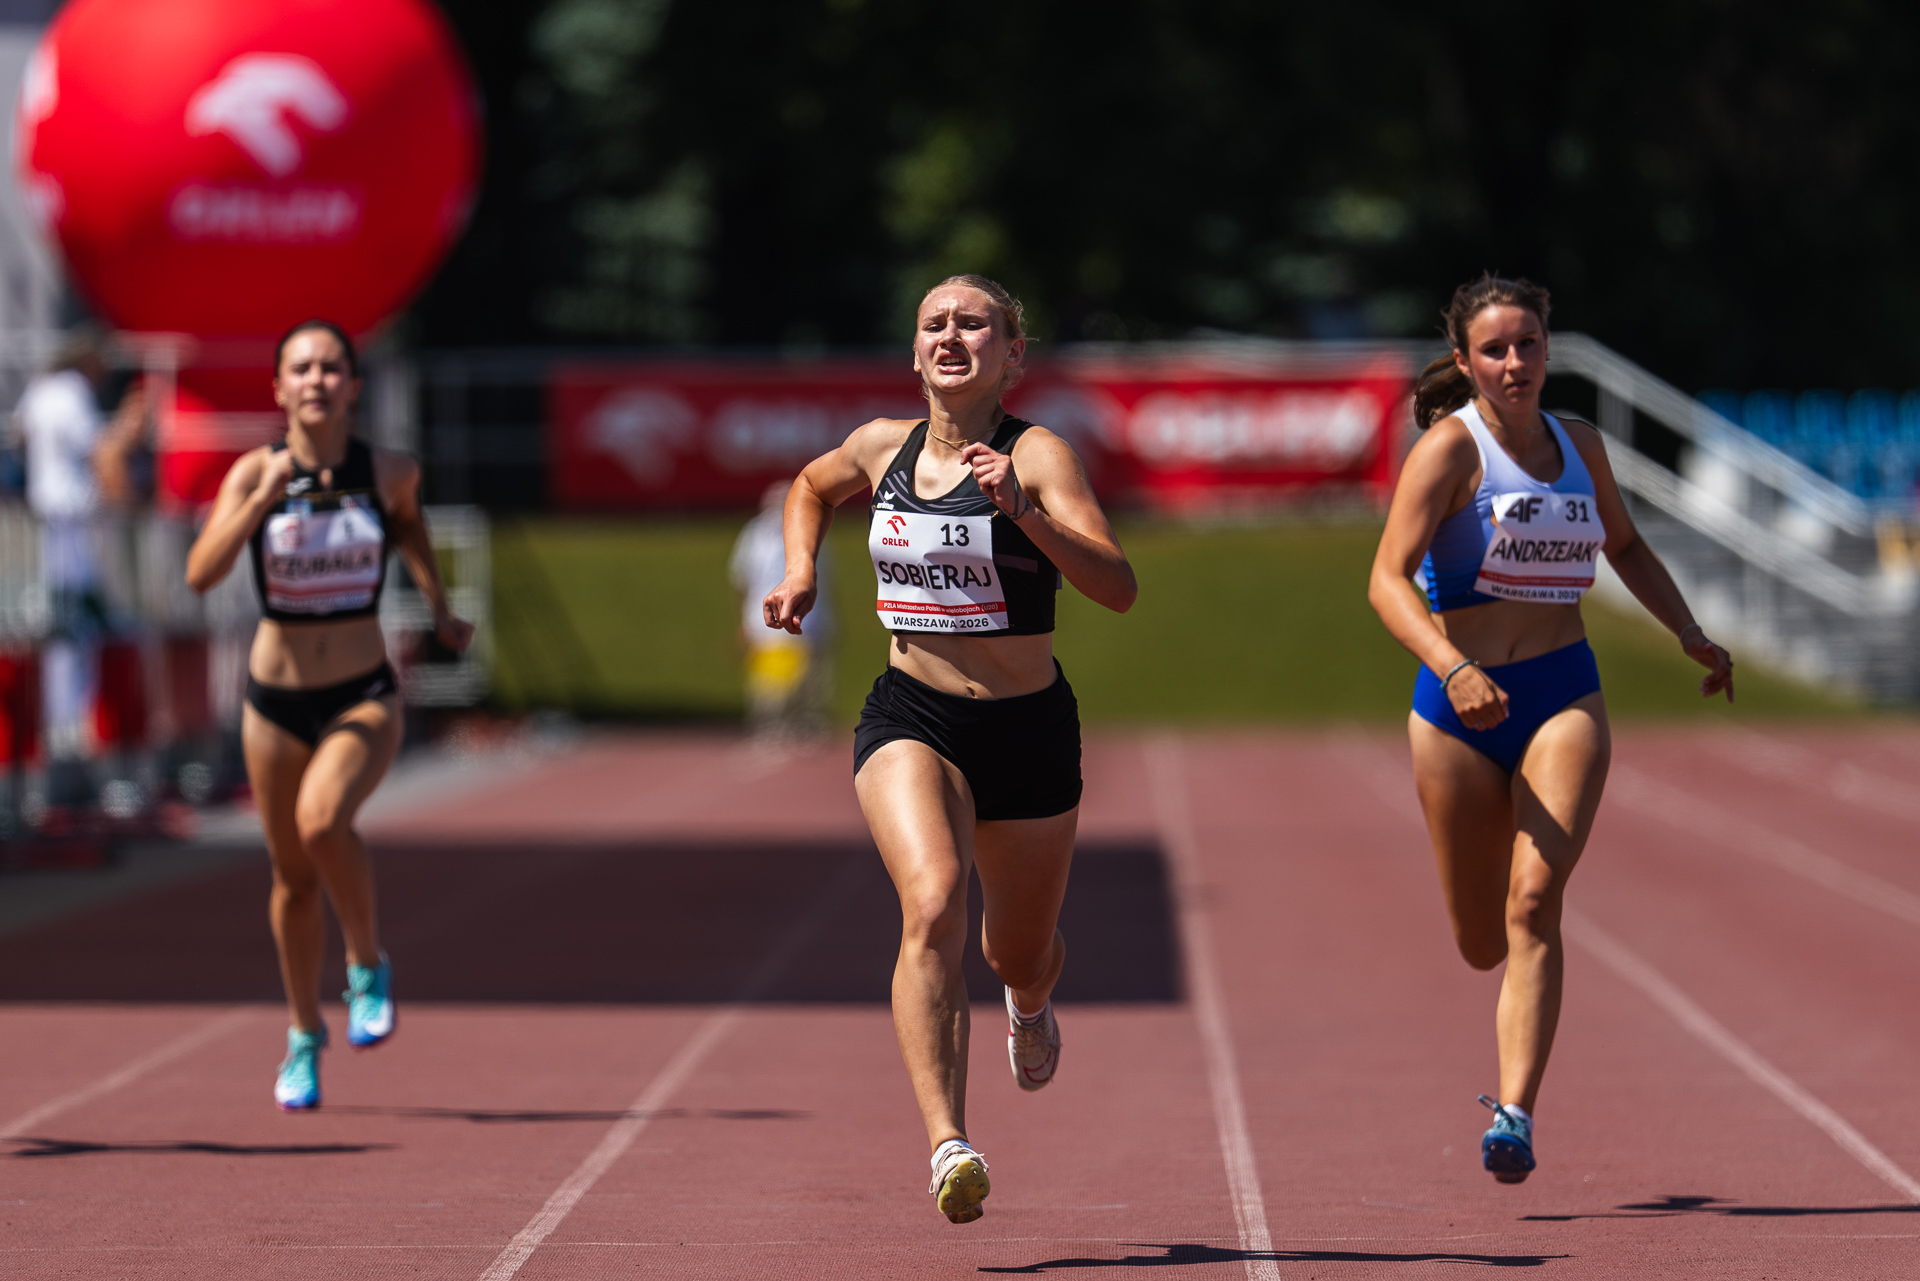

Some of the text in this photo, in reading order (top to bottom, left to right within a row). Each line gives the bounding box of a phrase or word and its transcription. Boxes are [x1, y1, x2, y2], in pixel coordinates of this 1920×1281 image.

[1505, 497, 1543, 523] 4F
[1565, 500, 1589, 523] 31
[882, 537, 909, 547] ORLEN
[940, 523, 970, 547] 13
[1491, 537, 1599, 563] ANDRZEJAK
[878, 560, 992, 590] SOBIERAJ
[1491, 584, 1556, 599] WARSZAWA
[896, 603, 925, 611] Mistrzostwa
[893, 616, 989, 629] WARSZAWA 2026
